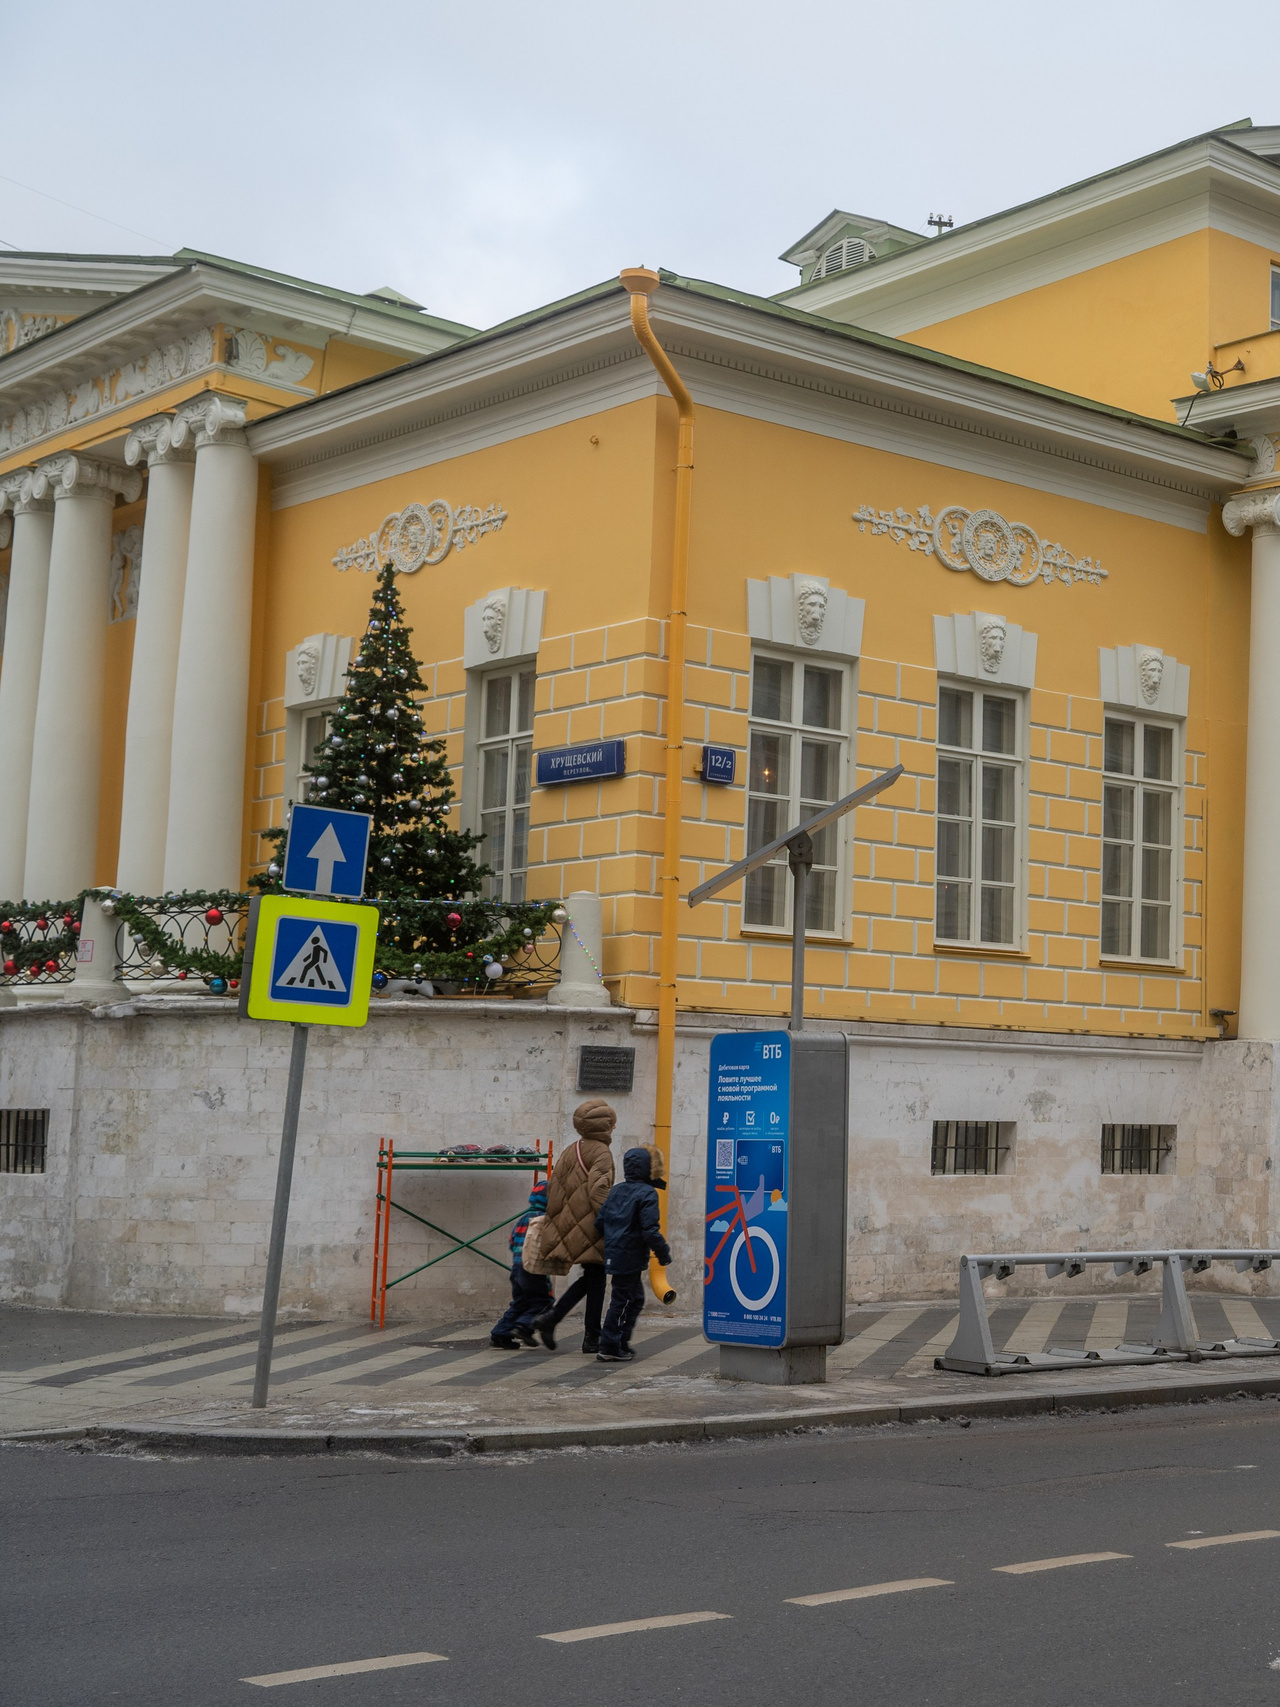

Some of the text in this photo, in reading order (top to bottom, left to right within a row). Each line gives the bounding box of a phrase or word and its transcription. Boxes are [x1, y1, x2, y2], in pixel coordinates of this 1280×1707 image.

[550, 748, 603, 769] ХРУЩЕВСКИЙ
[711, 755, 732, 769] 12/2
[563, 767, 591, 776] ПЕРЕУЛОК
[762, 1044, 782, 1059] ВТБ
[739, 1076, 762, 1084] лучшее
[721, 1084, 740, 1092] новой
[740, 1083, 778, 1093] программой
